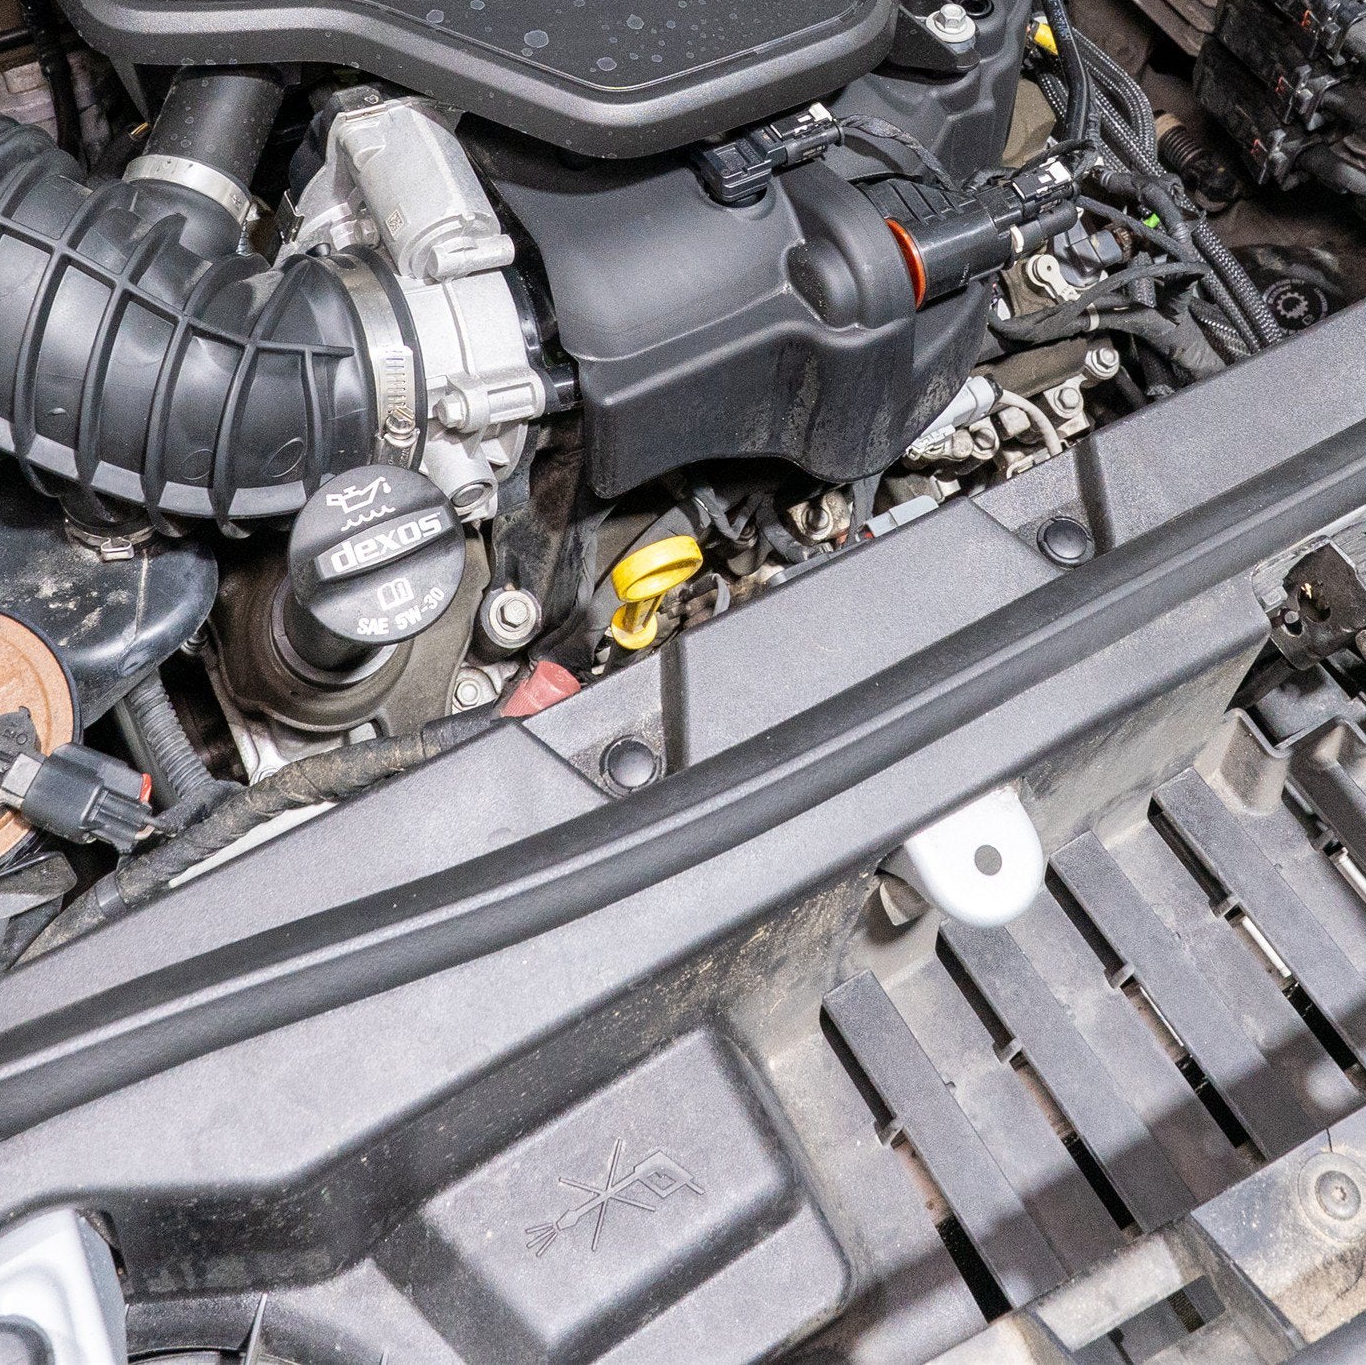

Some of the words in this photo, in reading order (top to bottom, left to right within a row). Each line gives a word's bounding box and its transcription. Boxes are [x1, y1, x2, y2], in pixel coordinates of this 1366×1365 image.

[331, 512, 442, 573] dexos
[357, 617, 389, 635] SAE
[395, 587, 445, 630] 5W-30
